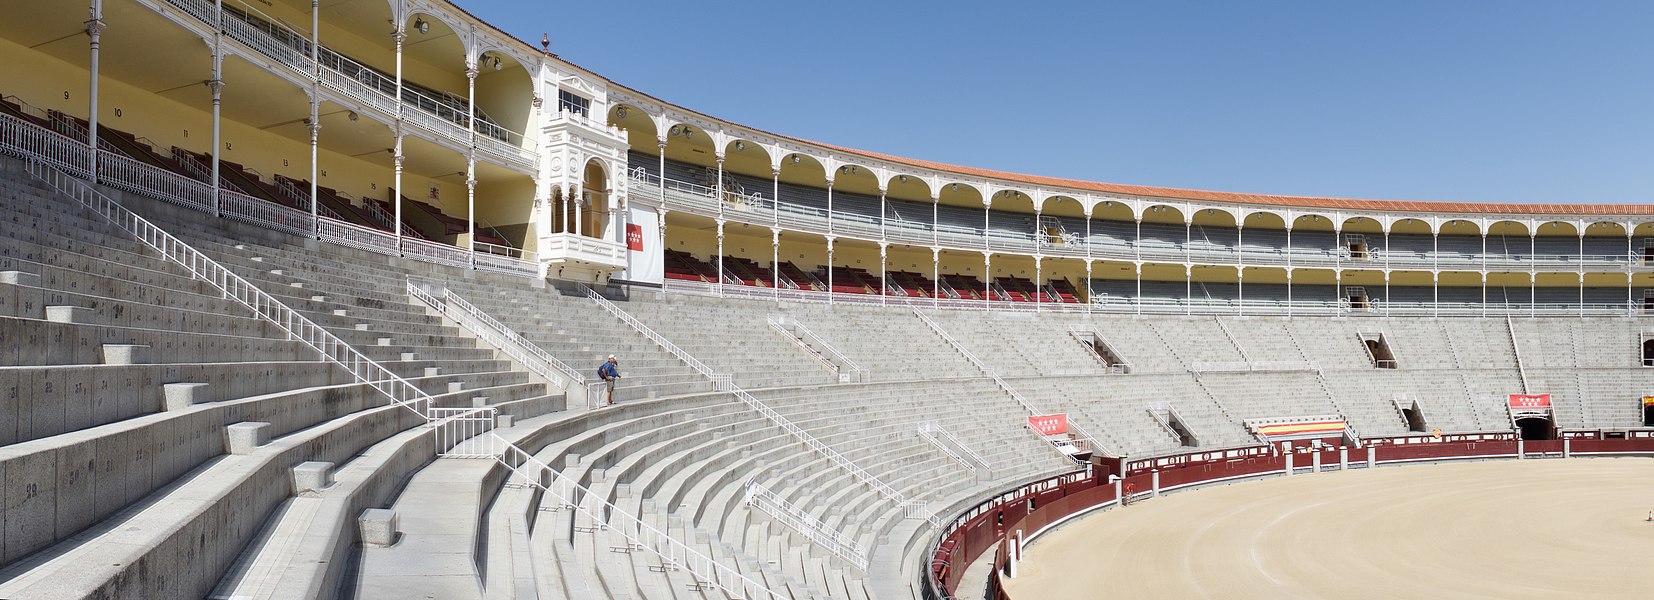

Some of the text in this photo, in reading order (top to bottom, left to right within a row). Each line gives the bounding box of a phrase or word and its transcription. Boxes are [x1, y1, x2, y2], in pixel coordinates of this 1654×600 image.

[64, 91, 69, 100] 9
[114, 107, 122, 118] 10
[225, 142, 232, 151] 12
